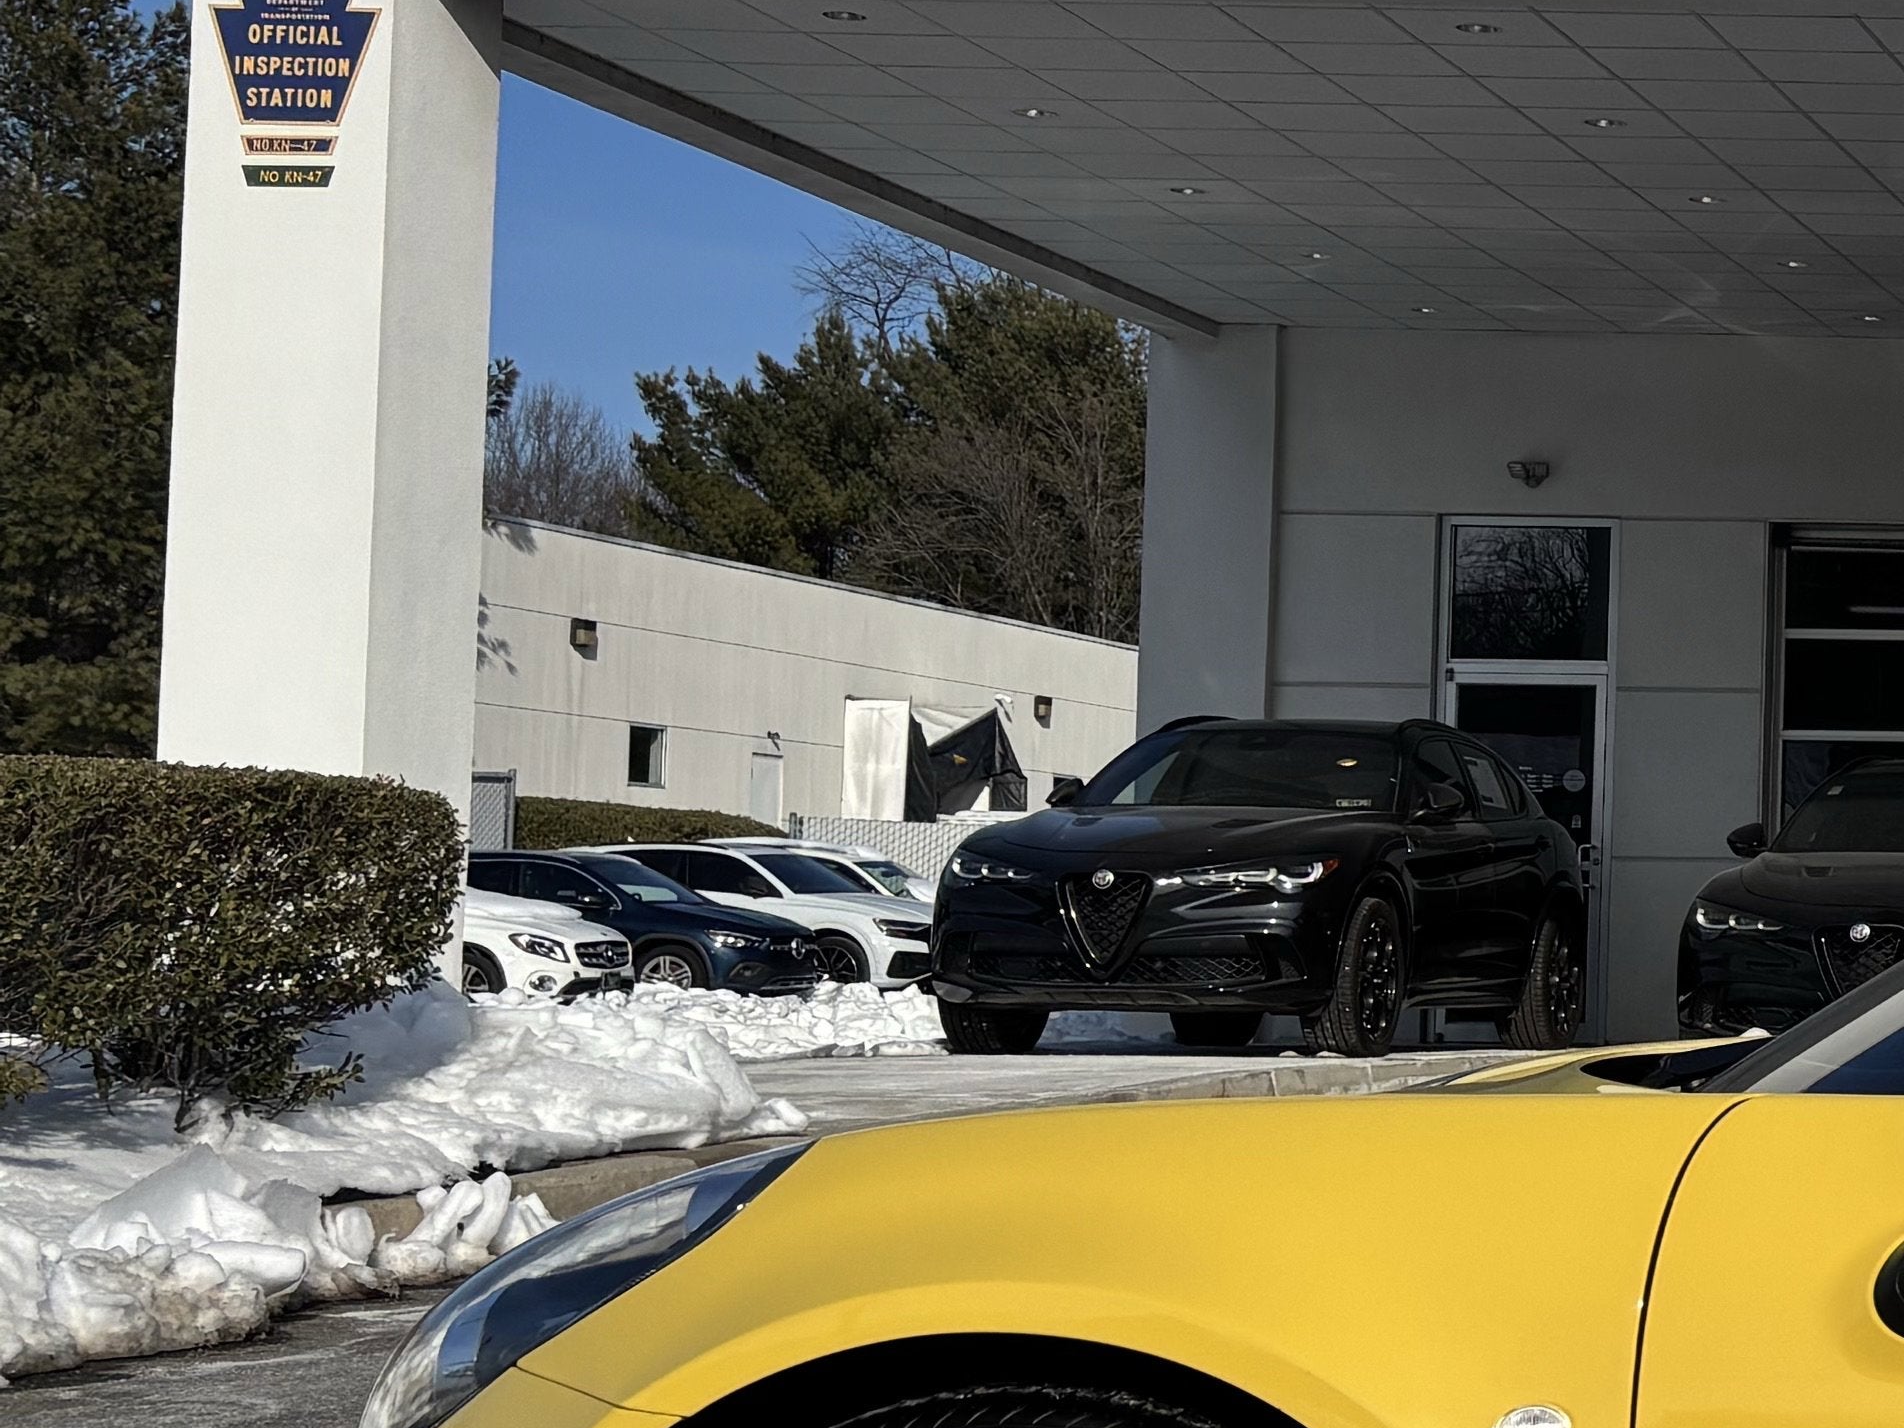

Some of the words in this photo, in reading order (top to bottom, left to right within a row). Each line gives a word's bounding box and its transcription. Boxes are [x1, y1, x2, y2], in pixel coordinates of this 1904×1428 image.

[248, 23, 343, 46] OFFICIAL
[235, 56, 350, 77] INSPECTION
[246, 87, 332, 108] STATION
[252, 139, 270, 152] NO
[259, 170, 279, 183] NO
[284, 171, 322, 183] KN-47
